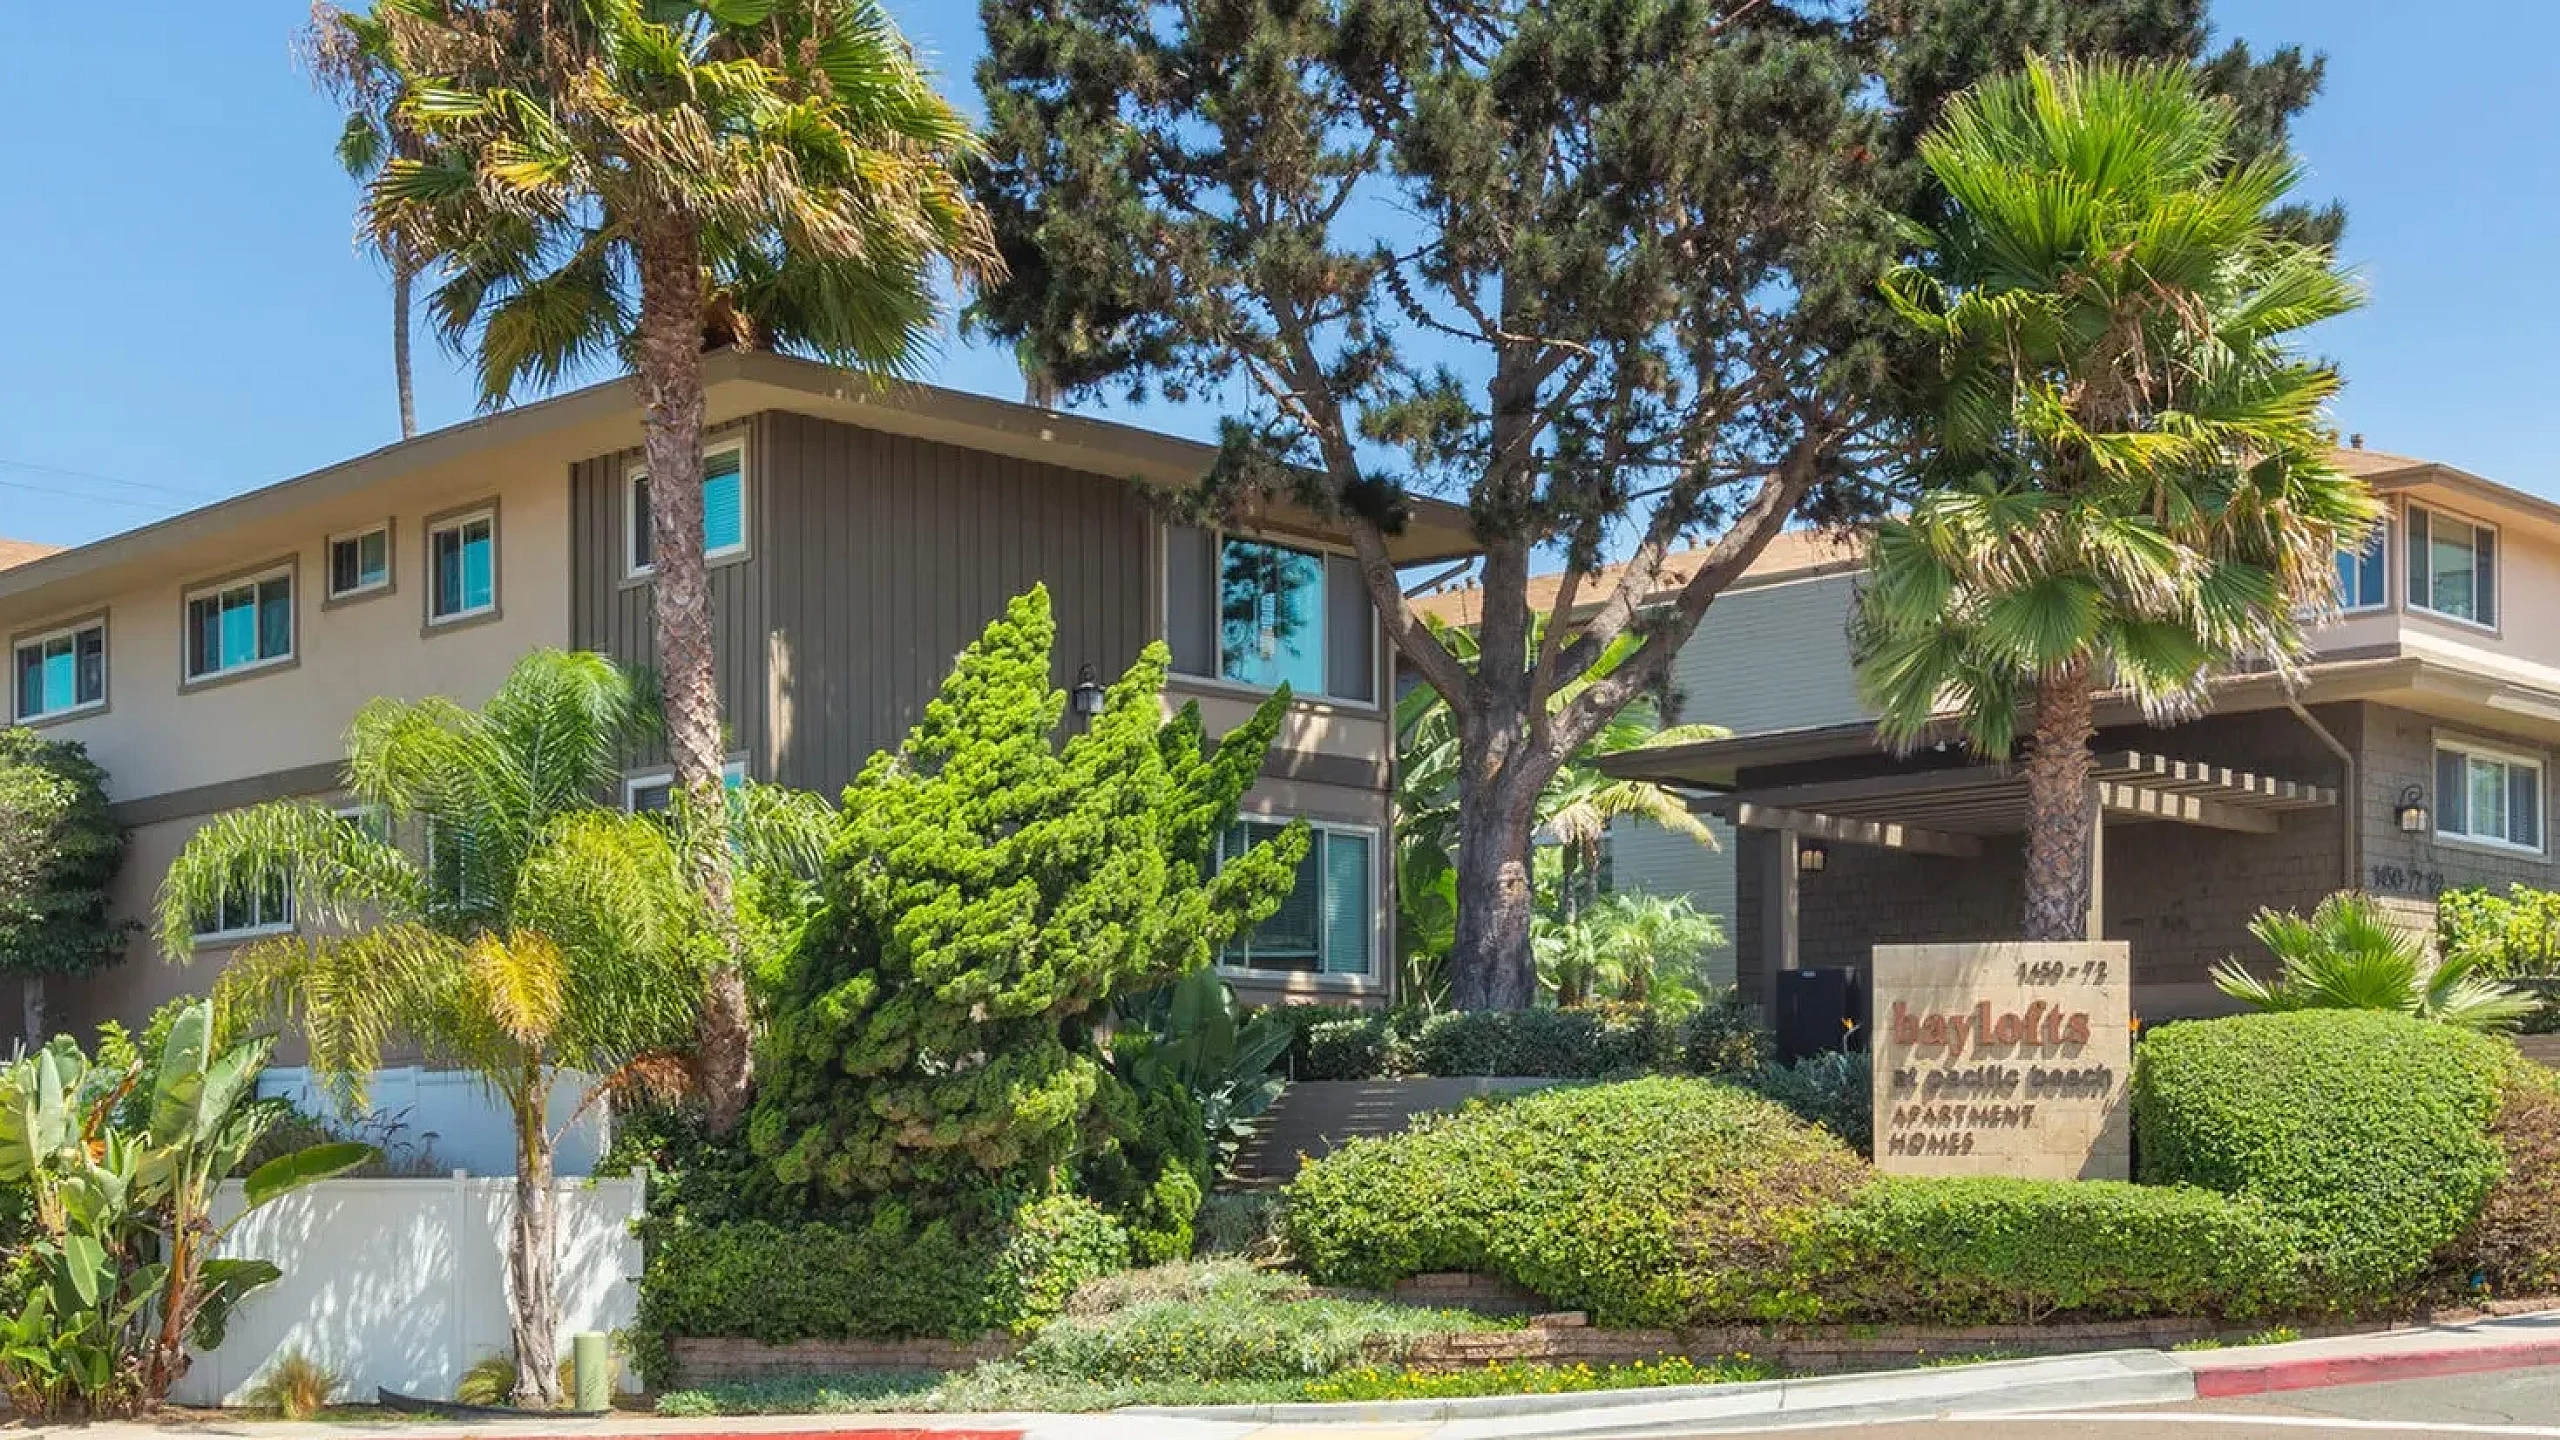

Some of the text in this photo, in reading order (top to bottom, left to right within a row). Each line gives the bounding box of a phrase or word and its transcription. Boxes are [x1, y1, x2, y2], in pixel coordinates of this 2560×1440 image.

[1892, 1000, 2090, 1057] baylofts
[1894, 1063, 2113, 1097] at pacific beach
[1892, 1104, 2035, 1129] APARTMENT
[1889, 1131, 1974, 1156] HOMES
